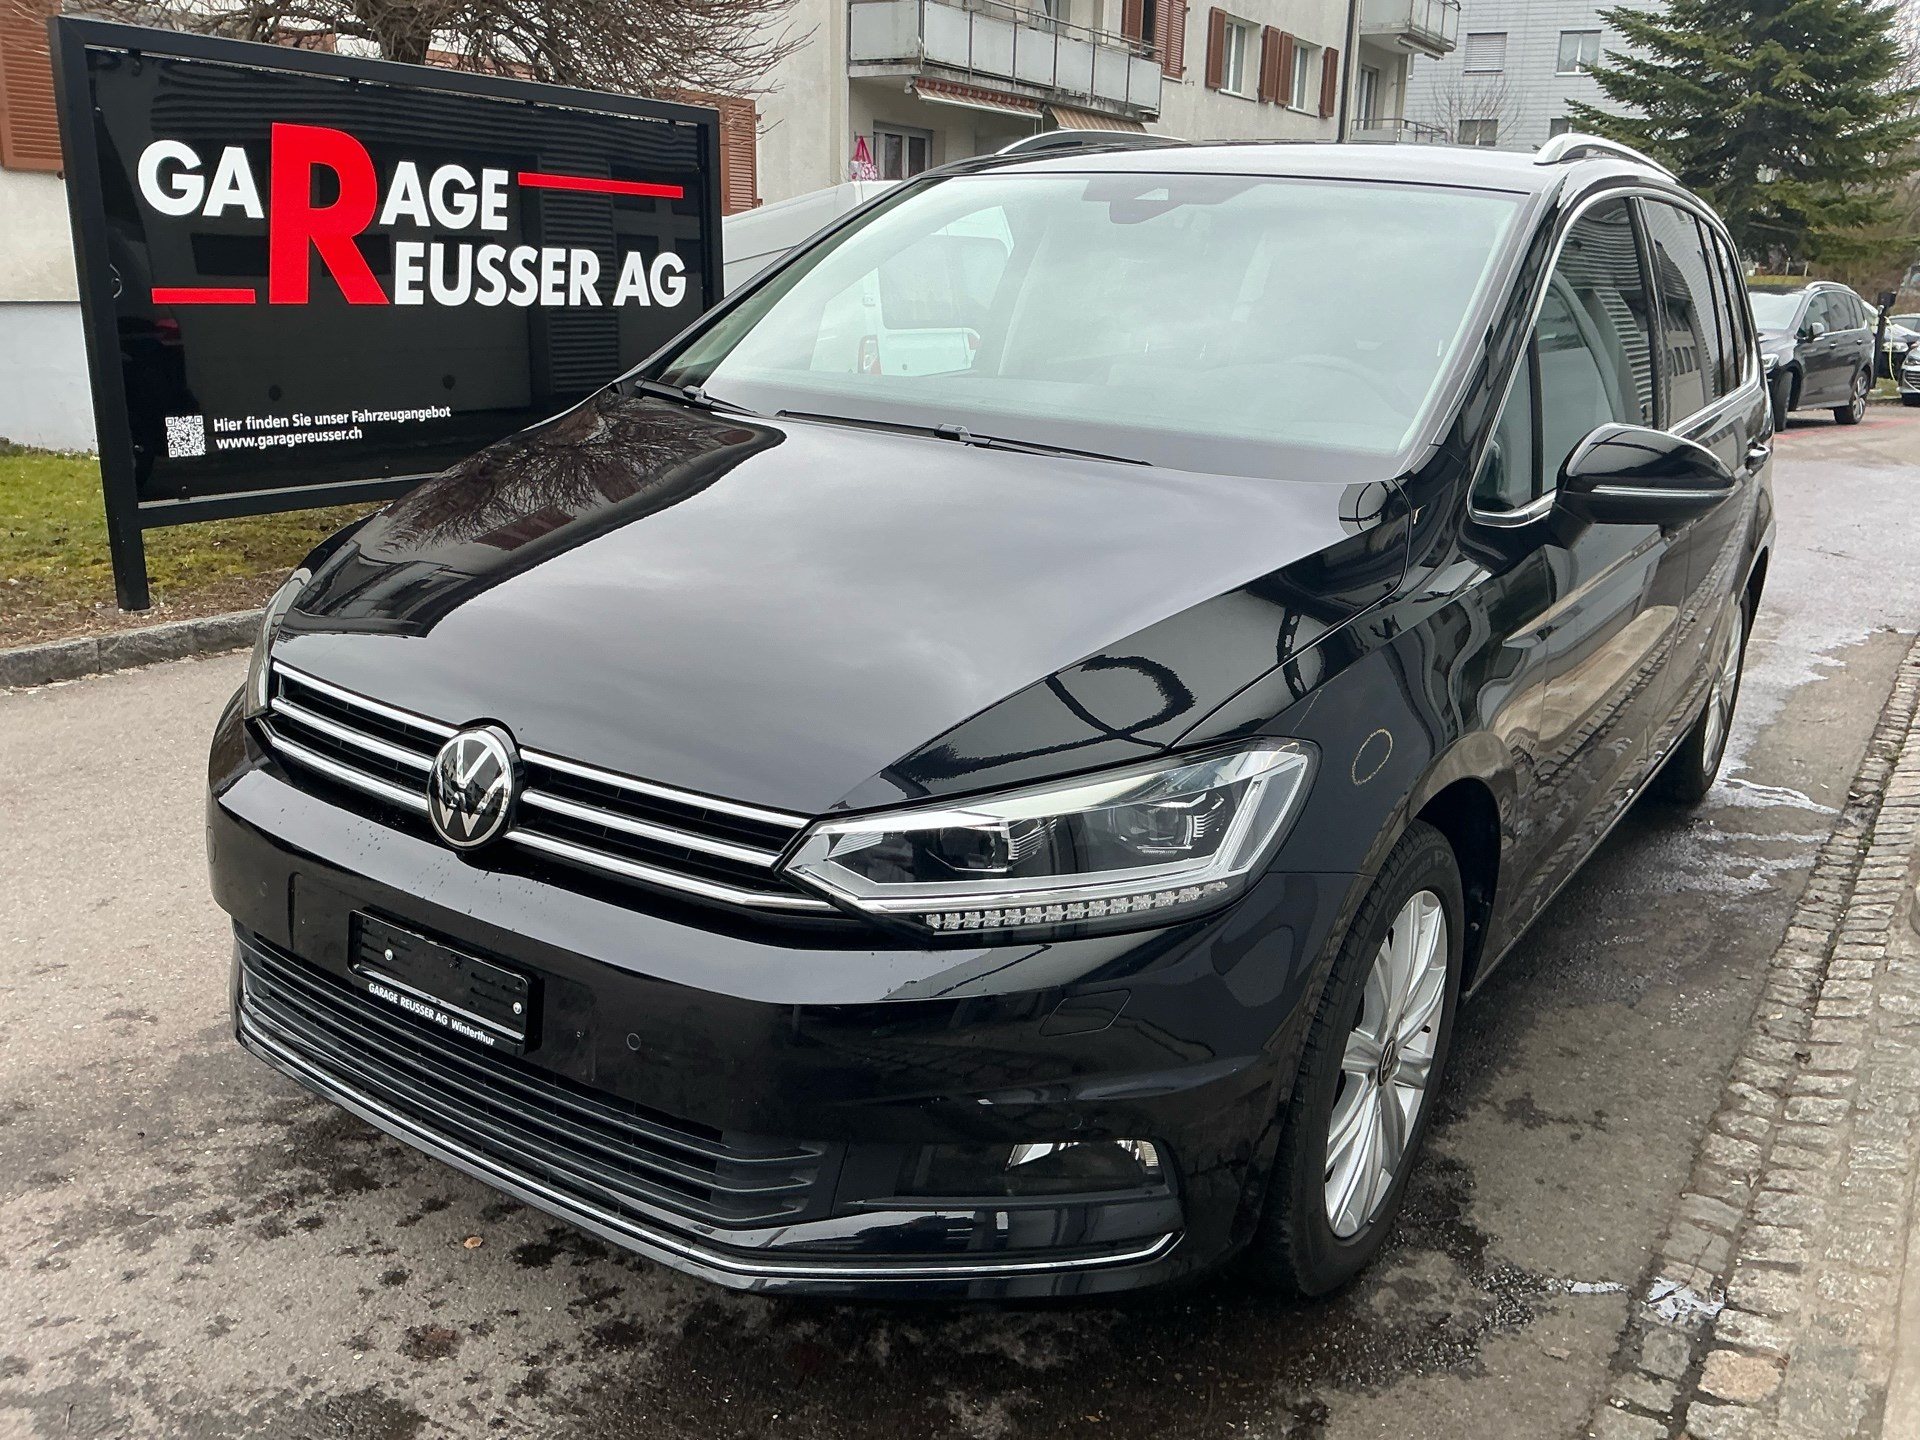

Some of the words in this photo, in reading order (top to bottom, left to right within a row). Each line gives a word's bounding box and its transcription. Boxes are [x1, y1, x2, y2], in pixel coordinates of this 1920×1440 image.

[138, 123, 509, 305] GARAGE
[612, 251, 687, 308] AG
[213, 418, 243, 432] Hier
[245, 414, 290, 430] finden
[292, 413, 312, 427] Sie
[314, 413, 349, 426] unser
[351, 405, 452, 423] Fahrzeugangebot
[215, 426, 363, 450] www.garagereusser.ch
[368, 982, 399, 1004] GARAGE
[400, 996, 435, 1020] REUSSER
[435, 1012, 448, 1026] AG
[451, 1018, 495, 1046] Winterthur
